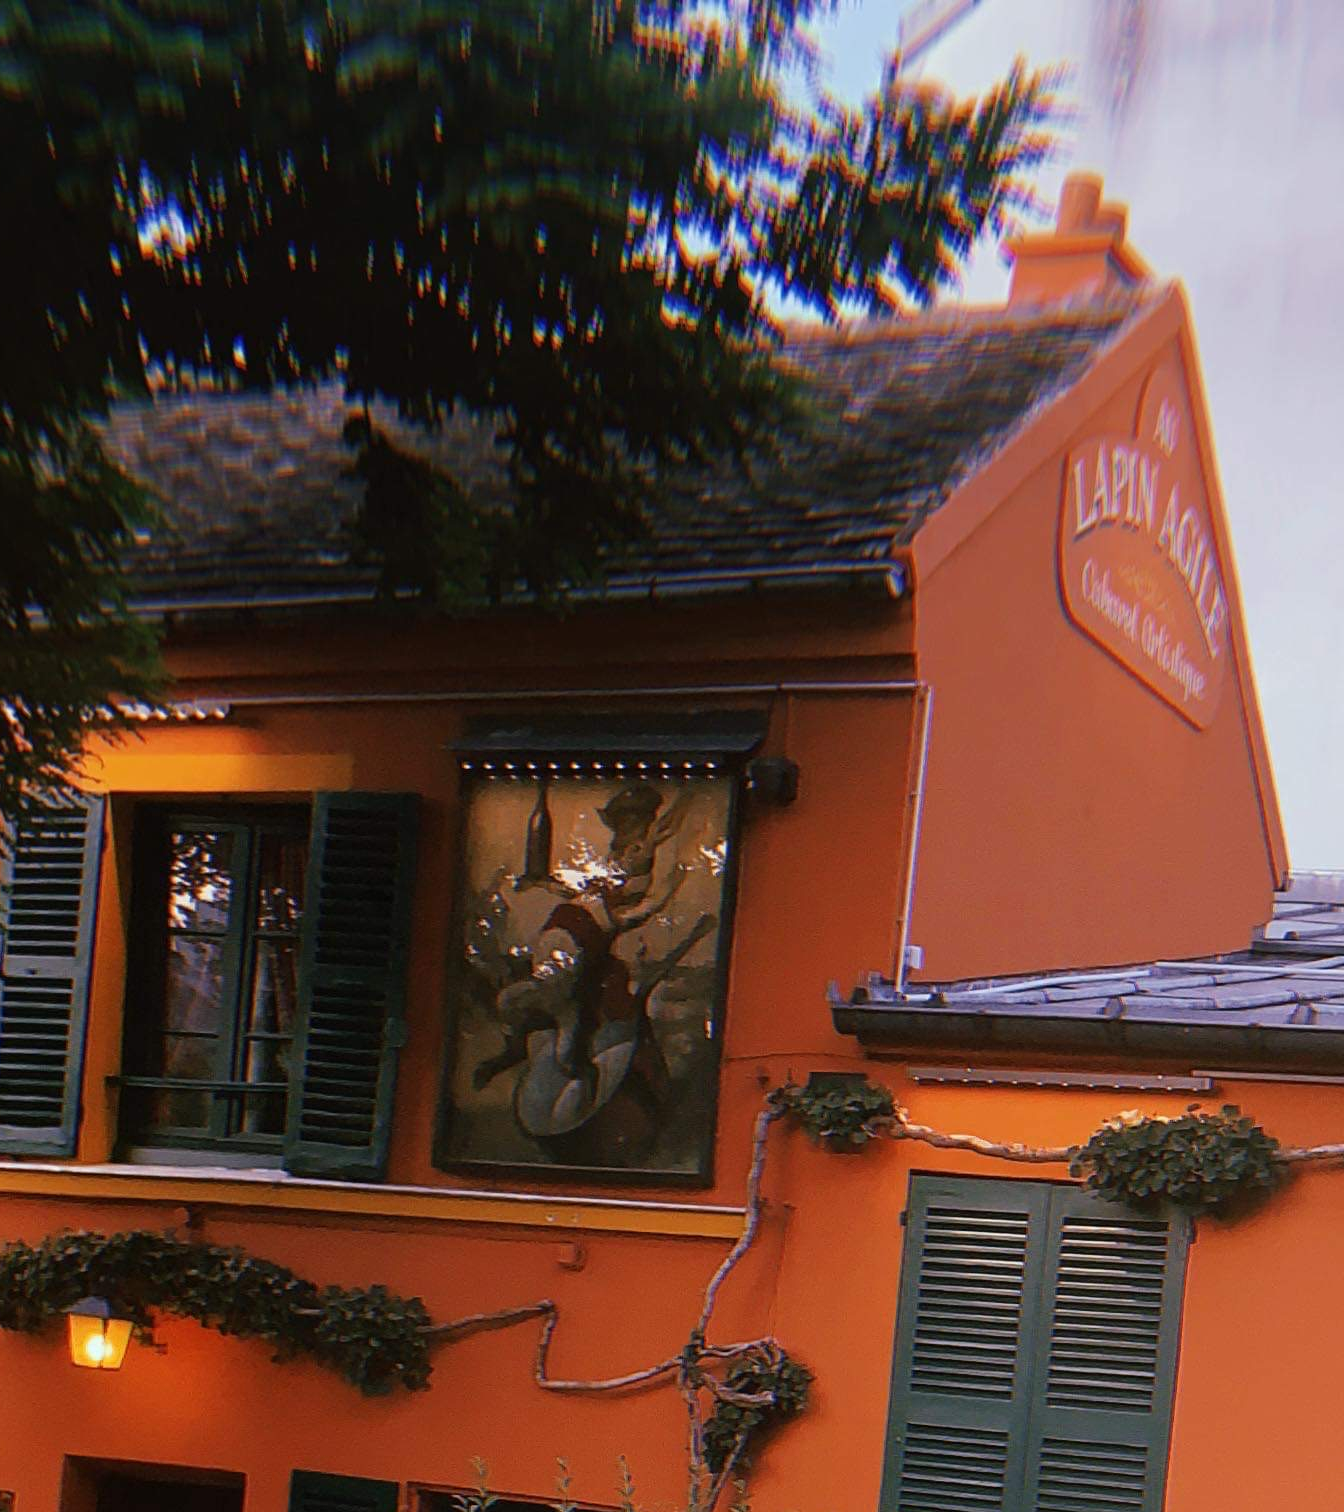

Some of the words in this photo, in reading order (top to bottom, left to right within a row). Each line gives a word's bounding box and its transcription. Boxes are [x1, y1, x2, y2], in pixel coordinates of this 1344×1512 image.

[1154, 396, 1181, 457] AU
[1073, 440, 1160, 538] LAPIN
[1159, 482, 1226, 659] AGILE
[1080, 558, 1141, 643] Cabaret
